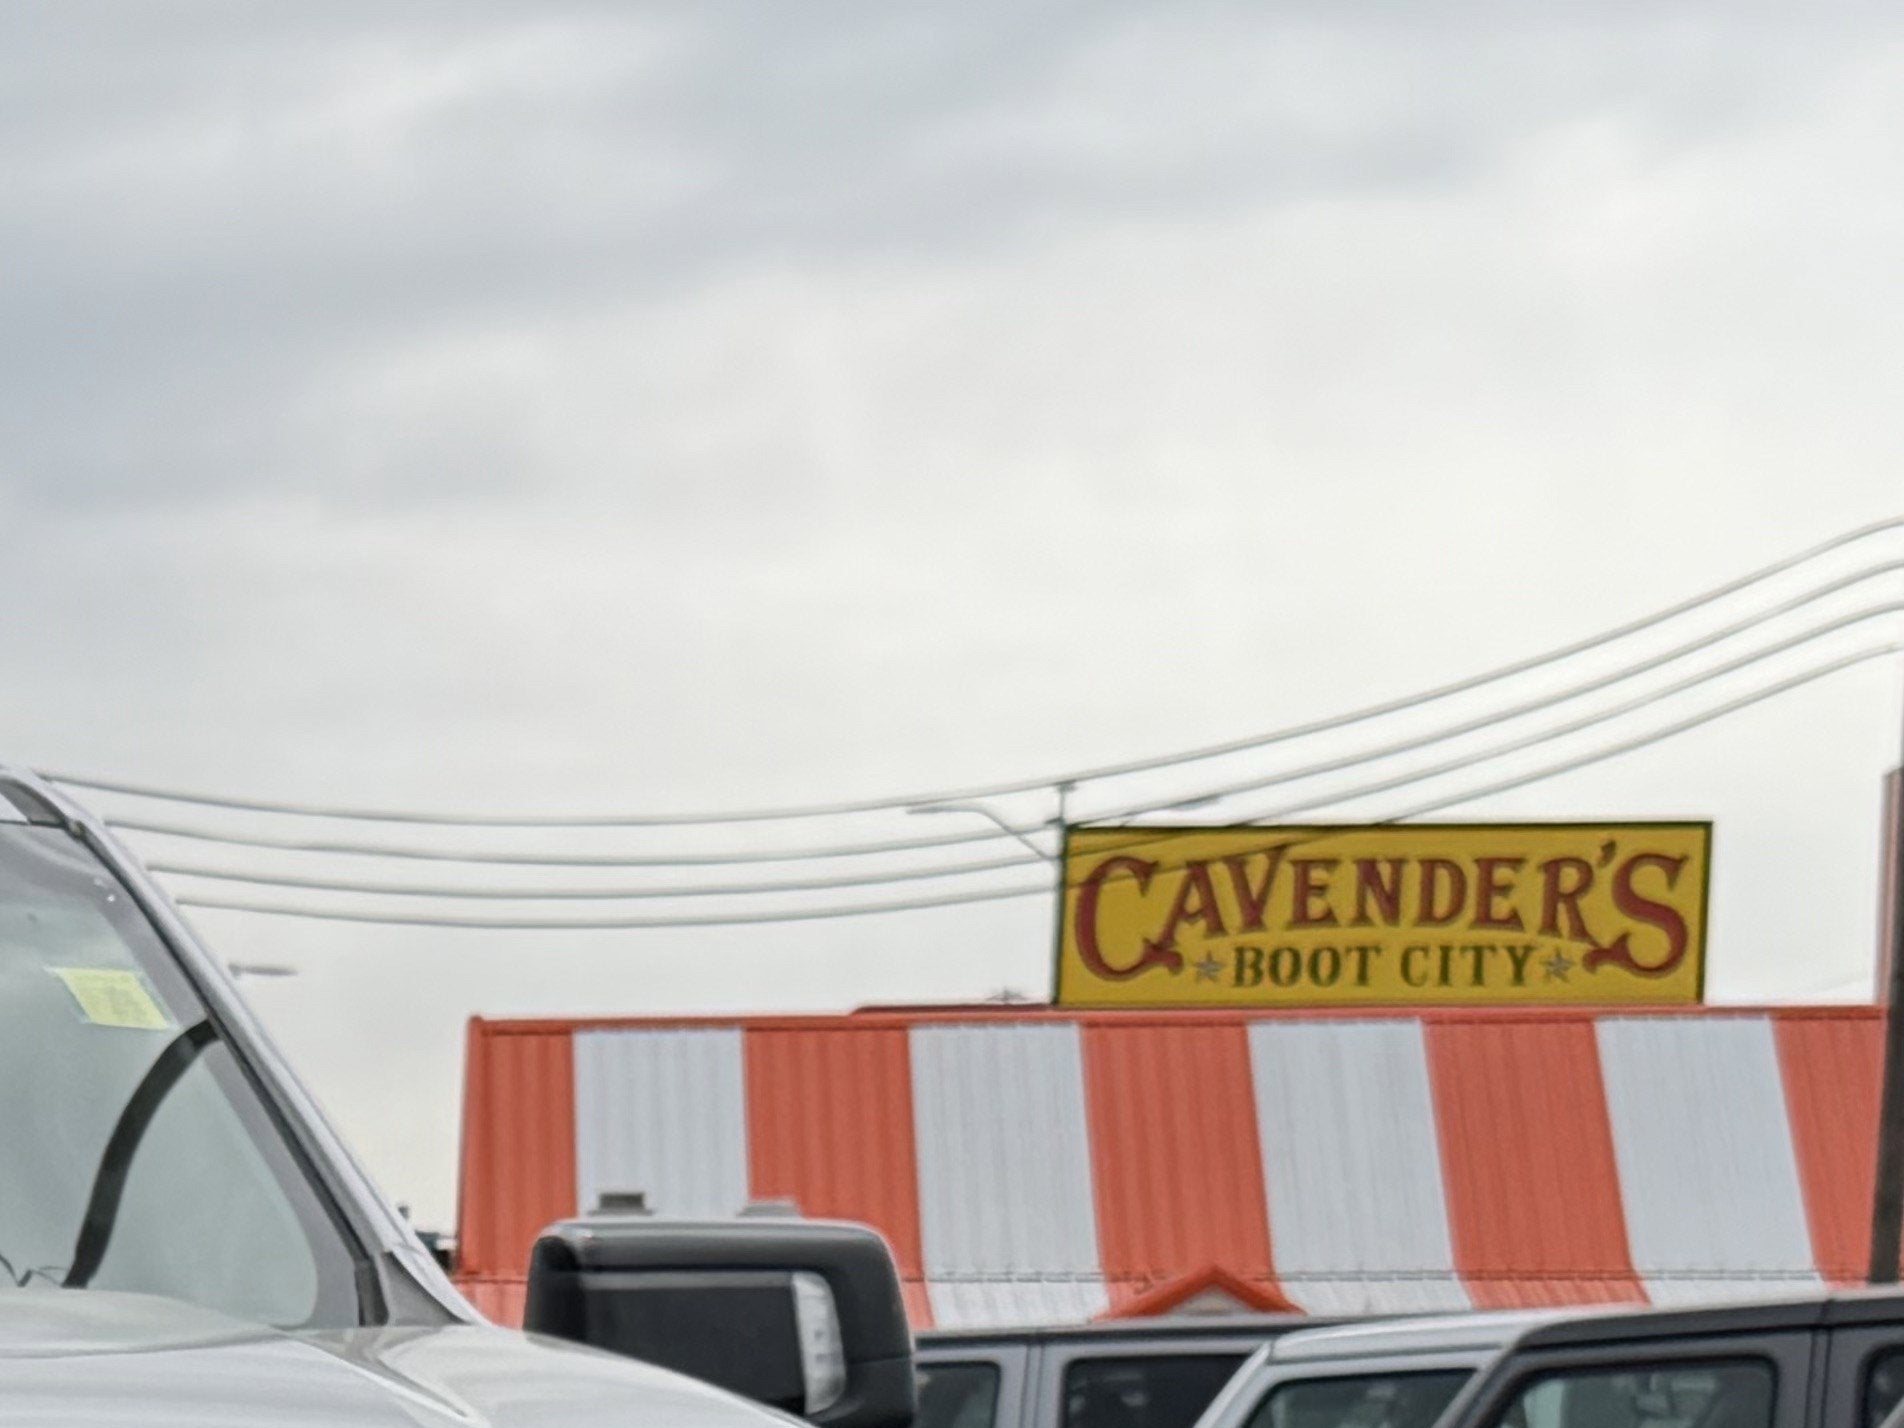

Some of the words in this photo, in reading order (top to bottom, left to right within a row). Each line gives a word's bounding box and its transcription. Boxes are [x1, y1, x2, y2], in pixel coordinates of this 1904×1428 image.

[1074, 839, 1690, 981] CAVENDER'S
[1233, 945, 1382, 988] BOOT
[1400, 945, 1539, 988] CITY
